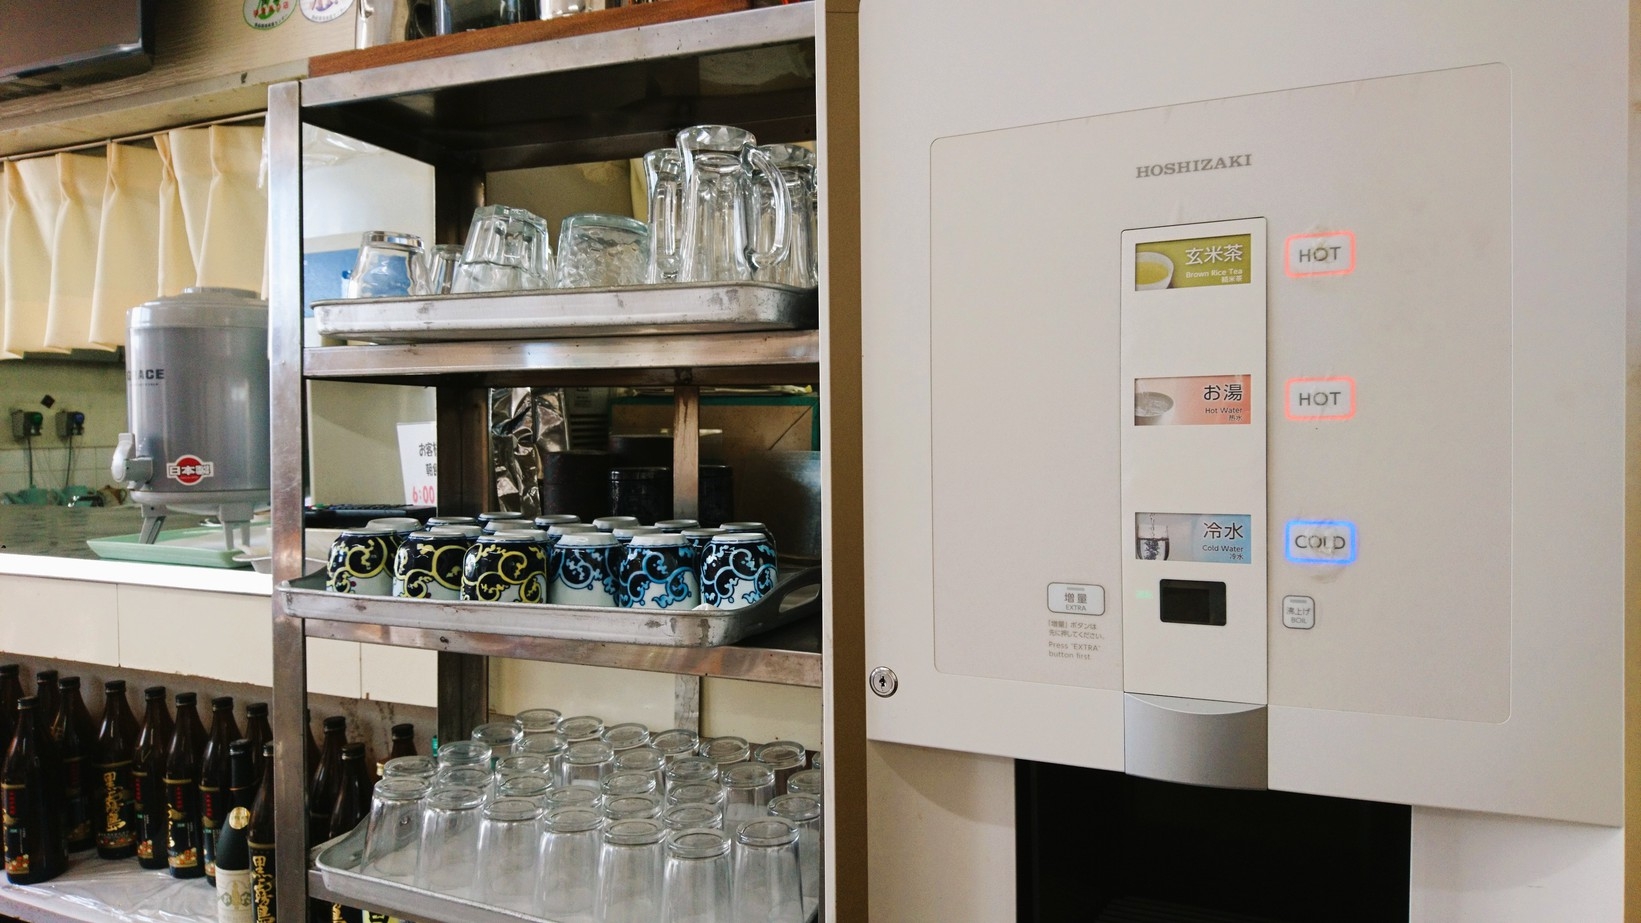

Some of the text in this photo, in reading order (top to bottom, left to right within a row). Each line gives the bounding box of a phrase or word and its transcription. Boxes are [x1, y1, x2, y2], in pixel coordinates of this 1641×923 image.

[1136, 153, 1252, 178] HOSHIZAKI
[1185, 243, 1243, 265] 玄米茶
[1299, 246, 1341, 263] HOT
[1185, 270, 1209, 278] Brown
[127, 368, 165, 381] GACE
[1203, 383, 1243, 402] お湯
[1299, 391, 1341, 406] HOT
[412, 485, 435, 504] 6:00
[1203, 522, 1244, 540] 冷水
[1221, 545, 1244, 553] Water
[1295, 534, 1346, 551] COLD
[1048, 650, 1074, 659] button
